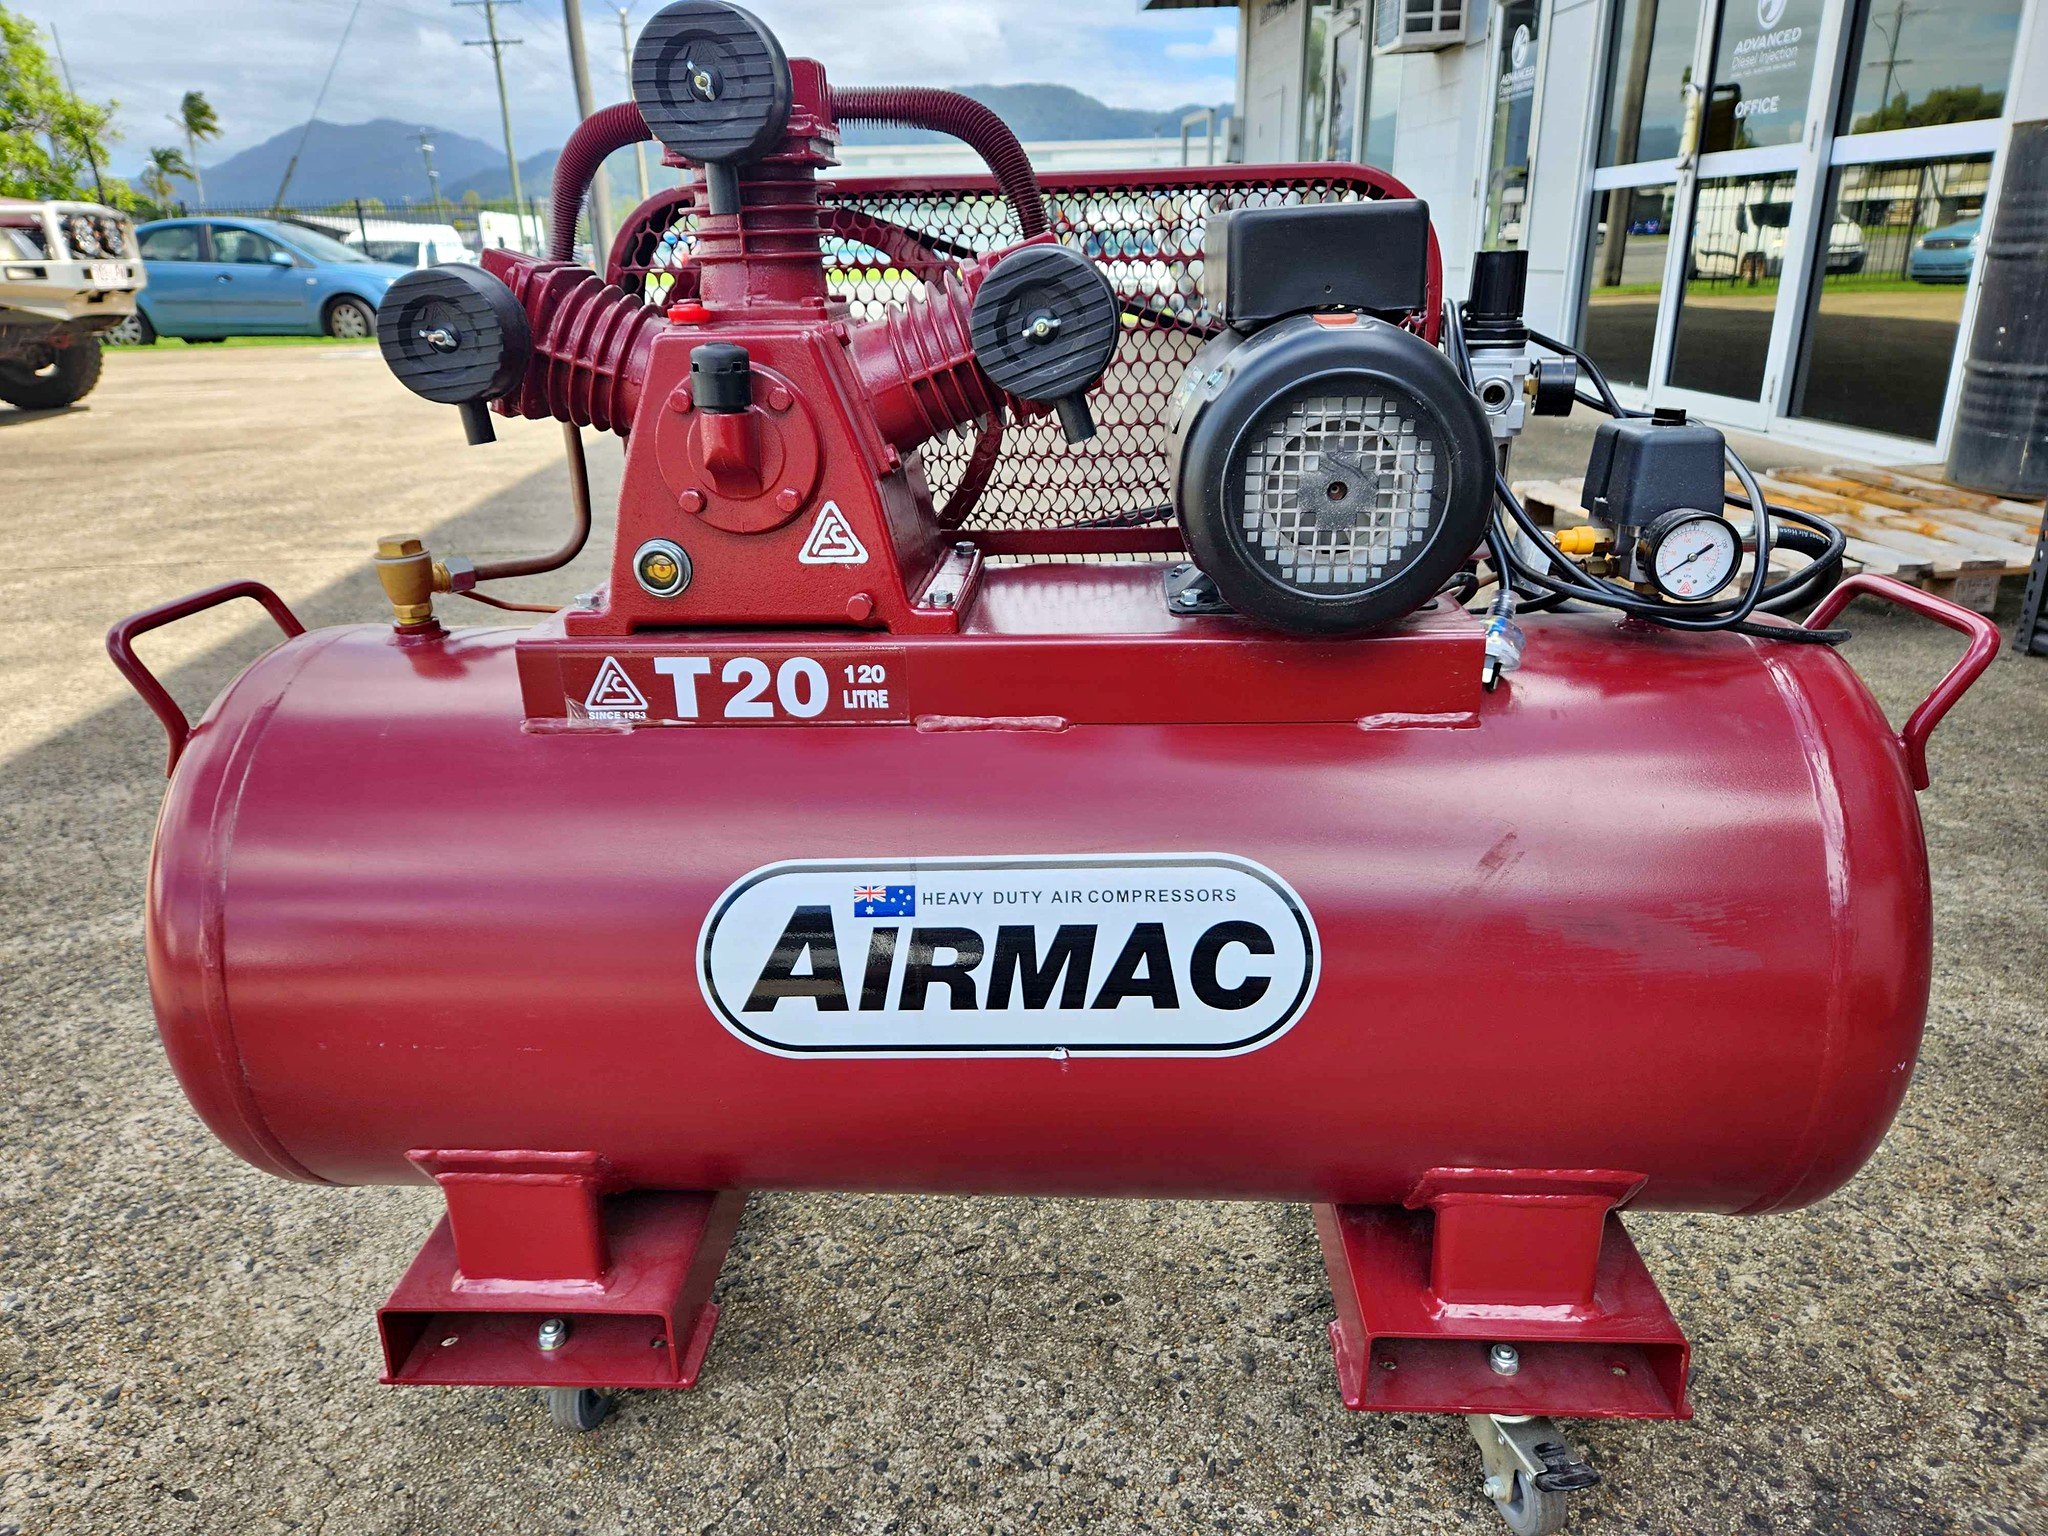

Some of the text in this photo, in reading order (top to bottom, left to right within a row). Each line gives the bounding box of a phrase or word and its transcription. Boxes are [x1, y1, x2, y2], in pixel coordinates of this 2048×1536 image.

[1733, 27, 1802, 56] ADVANCED
[1731, 51, 1758, 71] Diesel
[1759, 46, 1798, 66] Injection
[1734, 95, 1780, 118] OFFICE
[844, 664, 886, 684] 120
[843, 689, 889, 709] LITRE
[588, 711, 647, 720] SINCE 1953
[922, 888, 1237, 905] HEAVY DUTY AIR COMPRESSORS
[742, 905, 1276, 1012] AIRMAC
